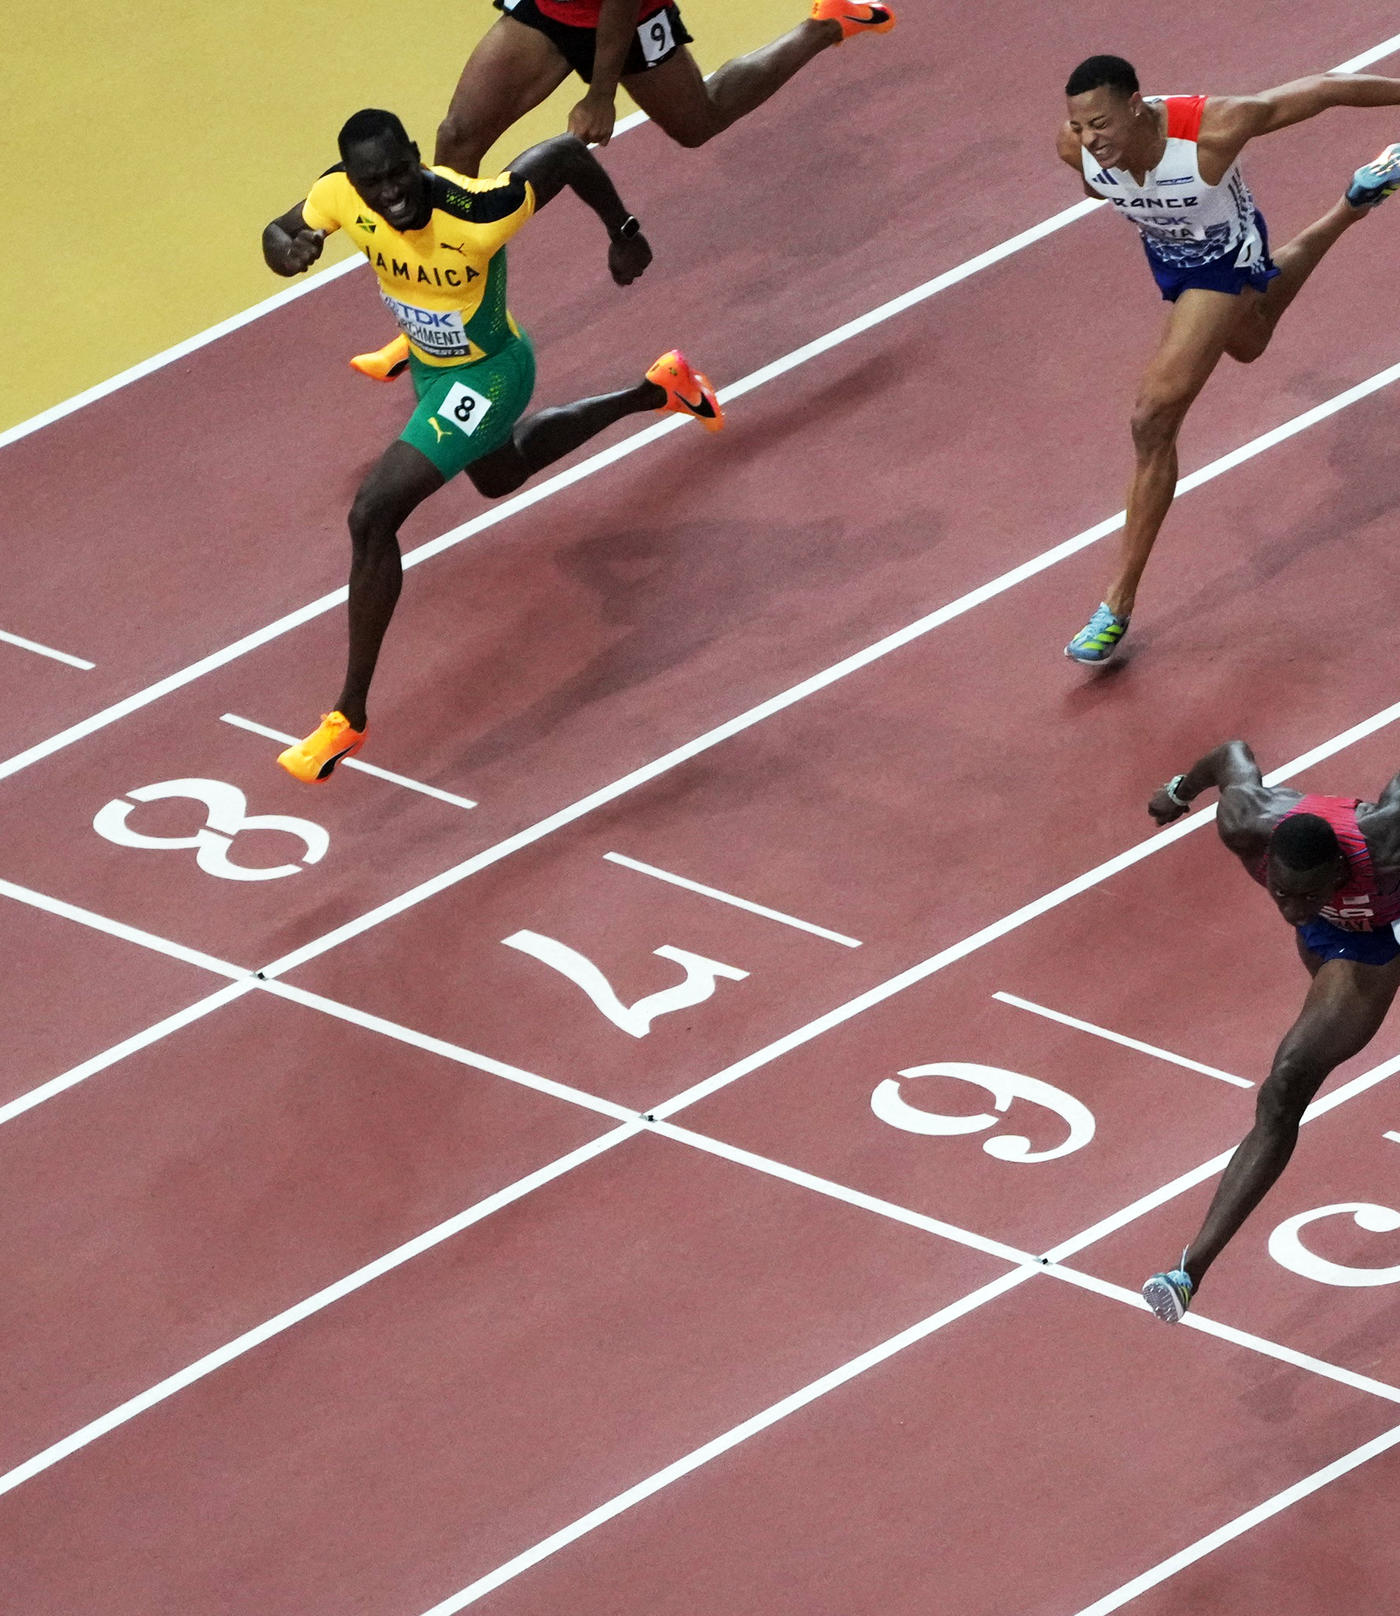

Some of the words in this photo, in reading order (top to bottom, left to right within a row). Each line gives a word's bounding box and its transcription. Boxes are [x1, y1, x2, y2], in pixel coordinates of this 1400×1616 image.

[651, 23, 665, 51] 9
[398, 302, 455, 328] TDK
[454, 396, 475, 422] 8
[93, 778, 329, 881] 8
[501, 930, 750, 1038] 7
[871, 1062, 1095, 1163] 6
